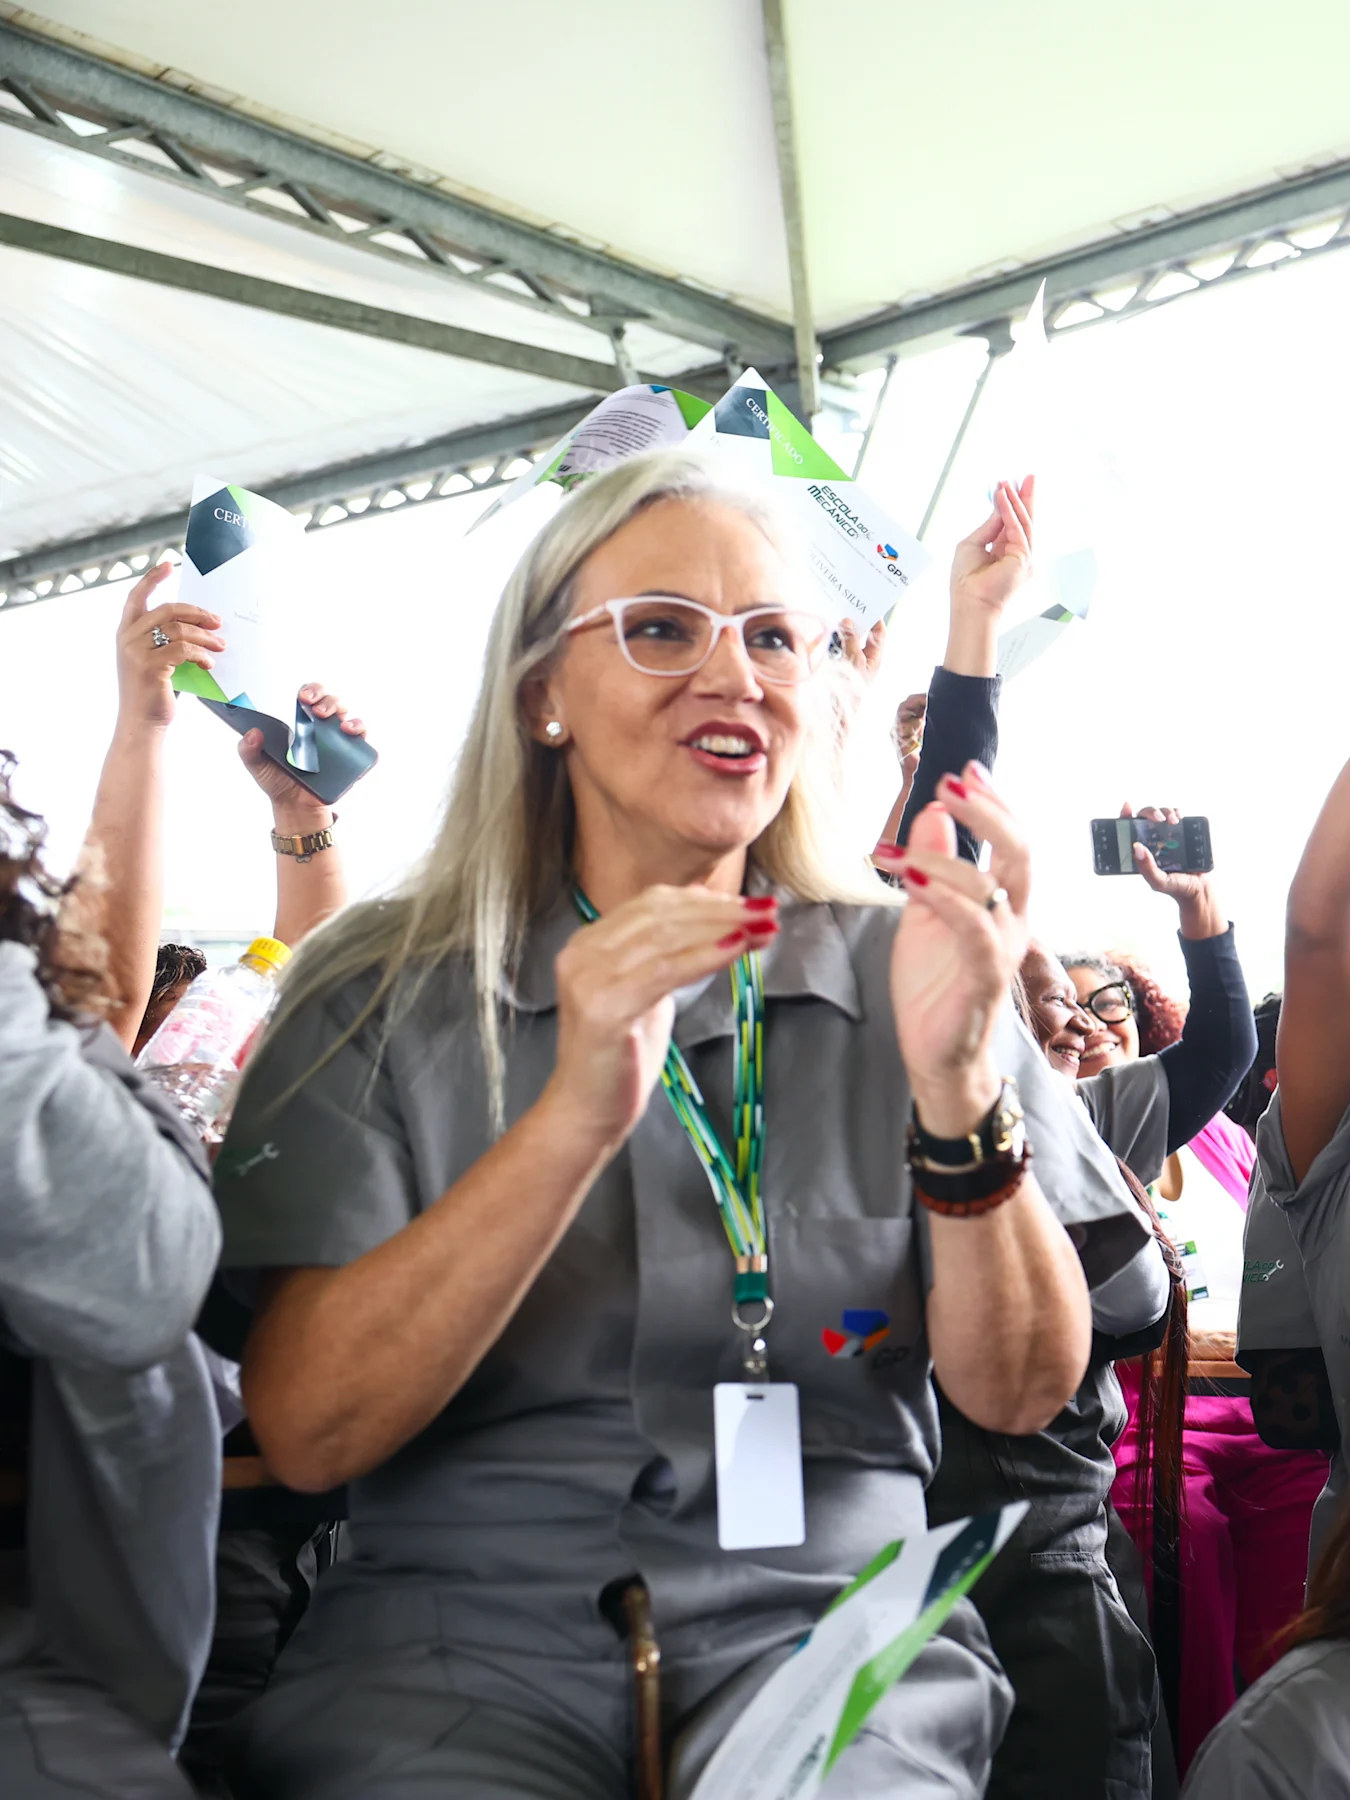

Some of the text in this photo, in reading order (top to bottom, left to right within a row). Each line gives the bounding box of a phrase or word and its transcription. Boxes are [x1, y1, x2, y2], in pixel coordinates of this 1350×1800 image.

[746, 397, 804, 465] CERTIFICADO
[820, 485, 869, 534] ESCOLA DO
[887, 563, 903, 577] GP
[842, 588, 867, 614] SILVA
